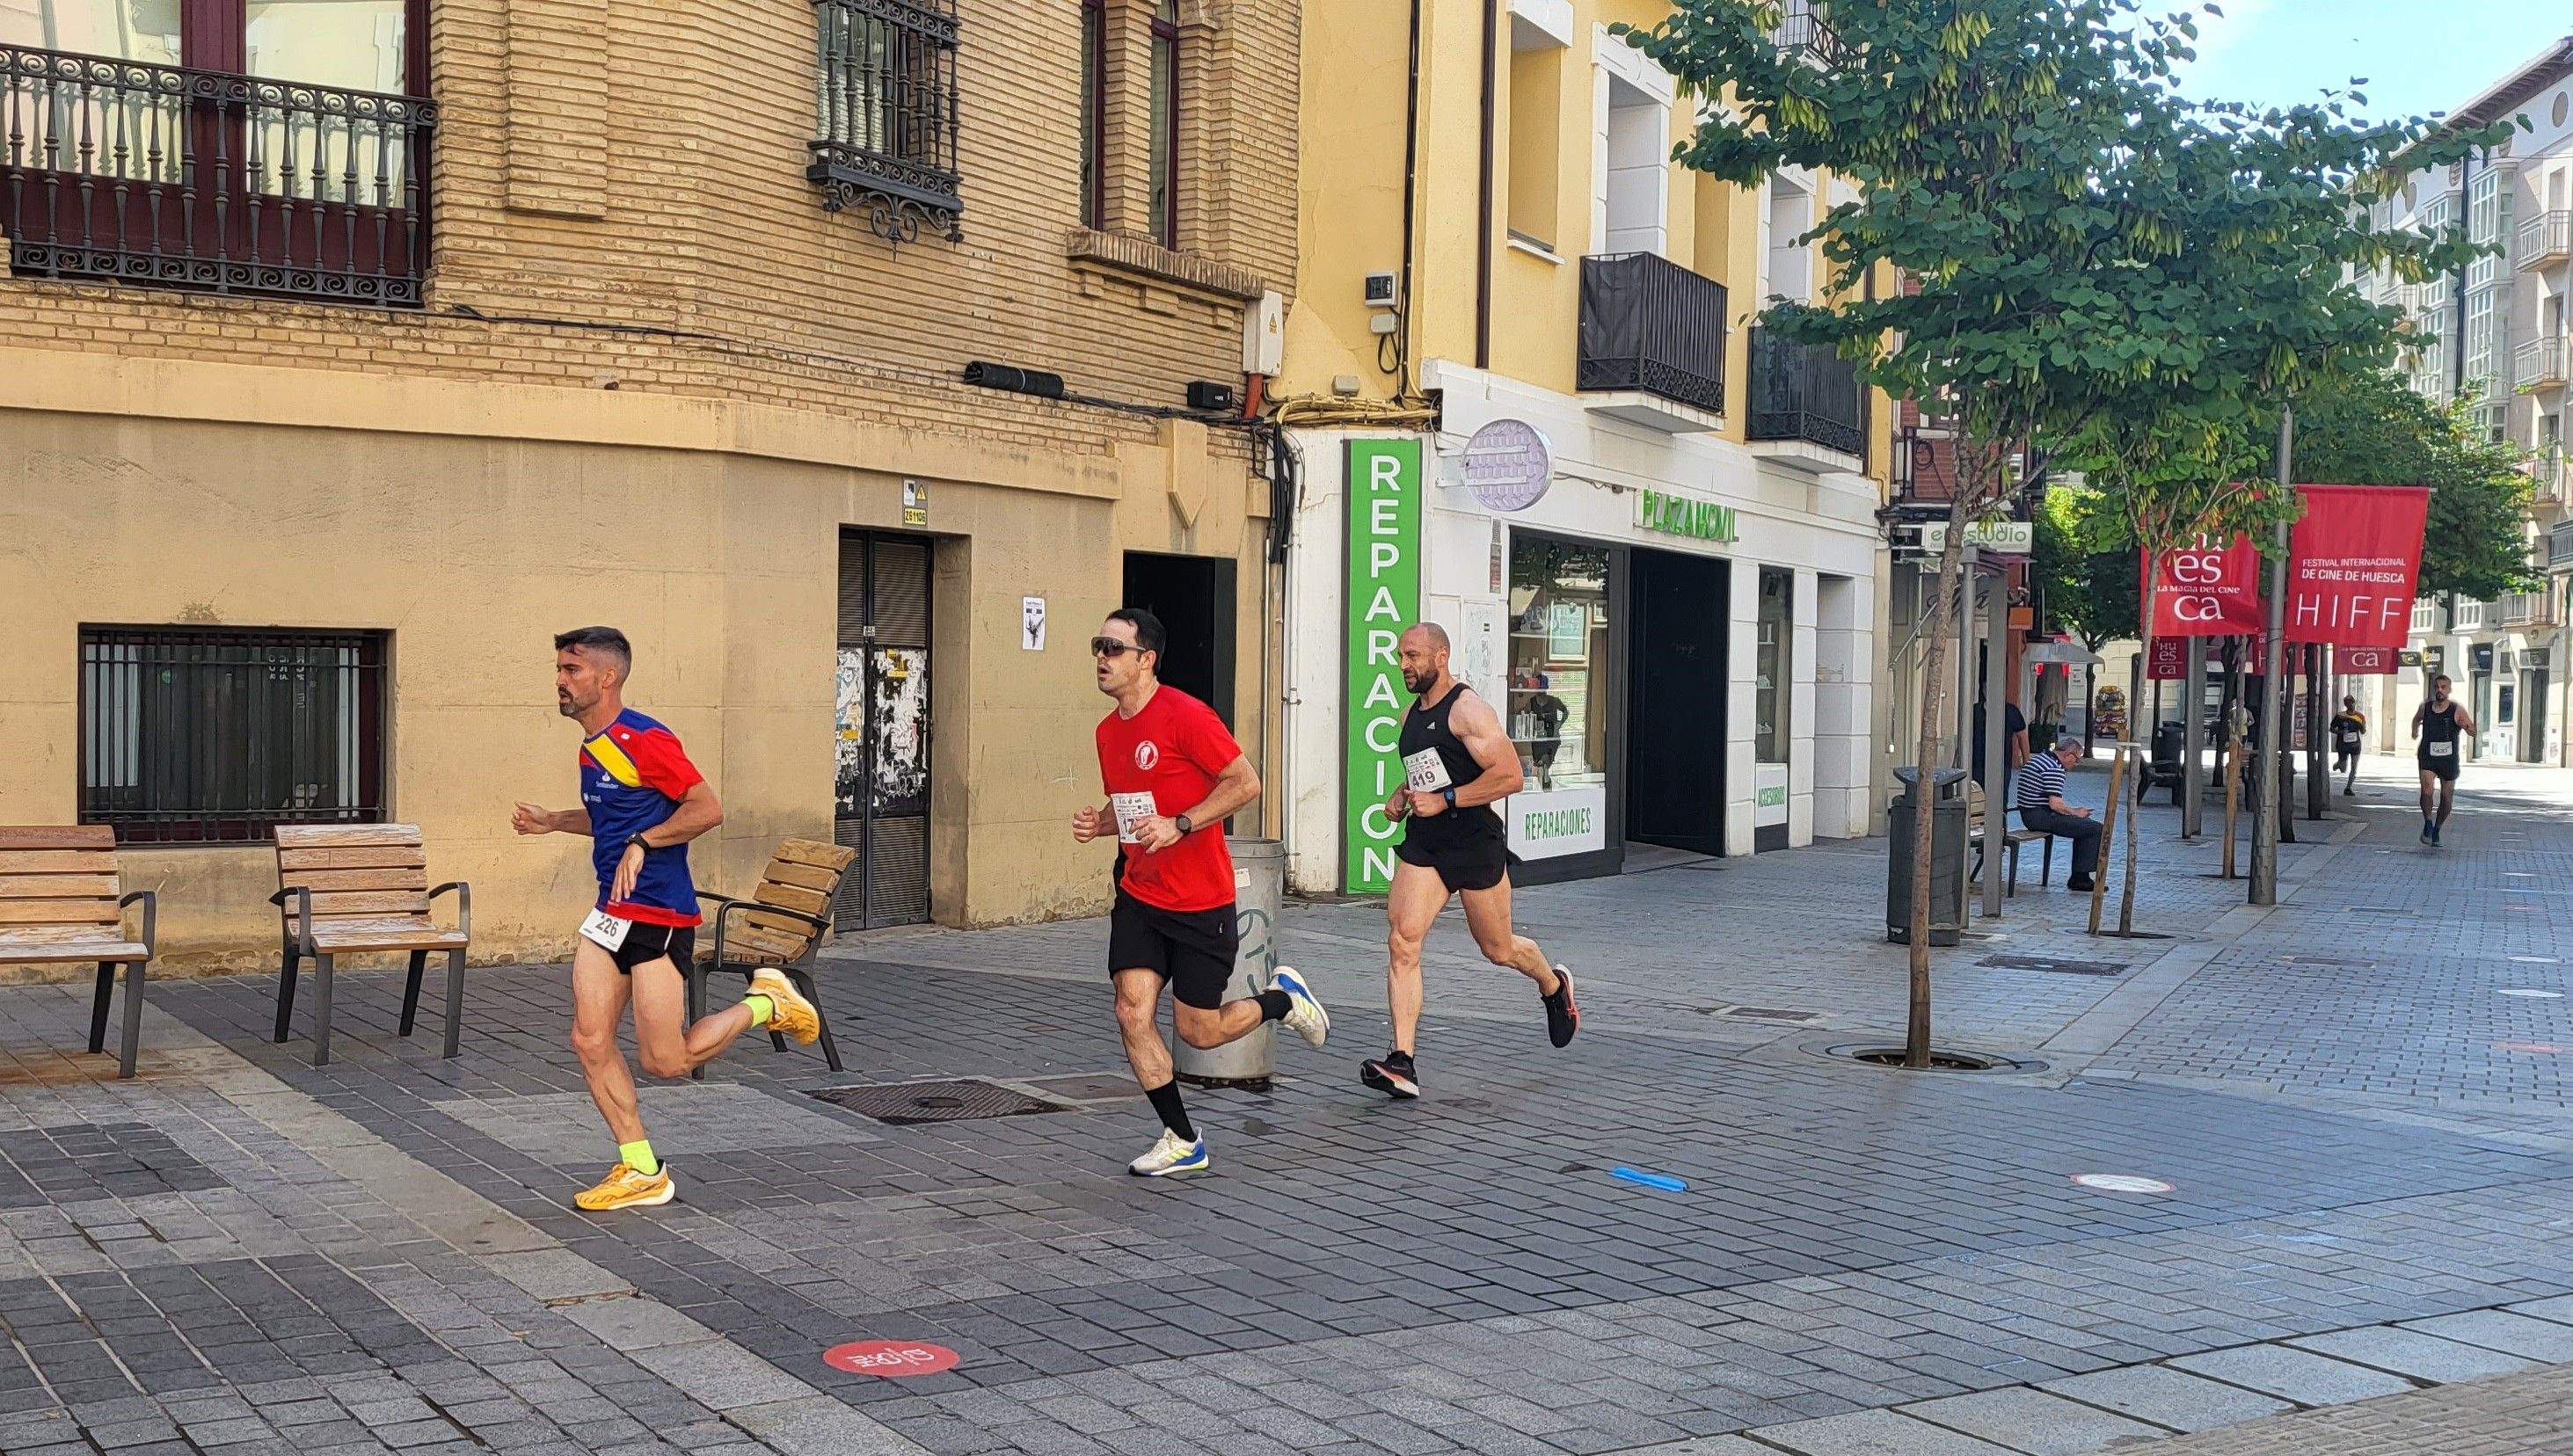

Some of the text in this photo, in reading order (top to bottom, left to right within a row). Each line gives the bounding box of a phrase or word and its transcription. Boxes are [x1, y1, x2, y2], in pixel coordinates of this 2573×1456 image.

[2175, 555, 2222, 584] es
[2302, 557, 2406, 568] FESTIVAL INTERNACIONAL
[2301, 569, 2405, 585] DE CINE DE HUESCA
[2174, 595, 2225, 621] ca
[2296, 593, 2403, 630] HIFF
[2159, 651, 2176, 661] es
[2351, 652, 2380, 667] ca
[1361, 455, 1402, 882] REPARACION
[2158, 665, 2176, 675] ca
[1412, 770, 1436, 788] 419
[1525, 807, 1592, 841] REPARACIONES
[595, 914, 619, 937] 226
